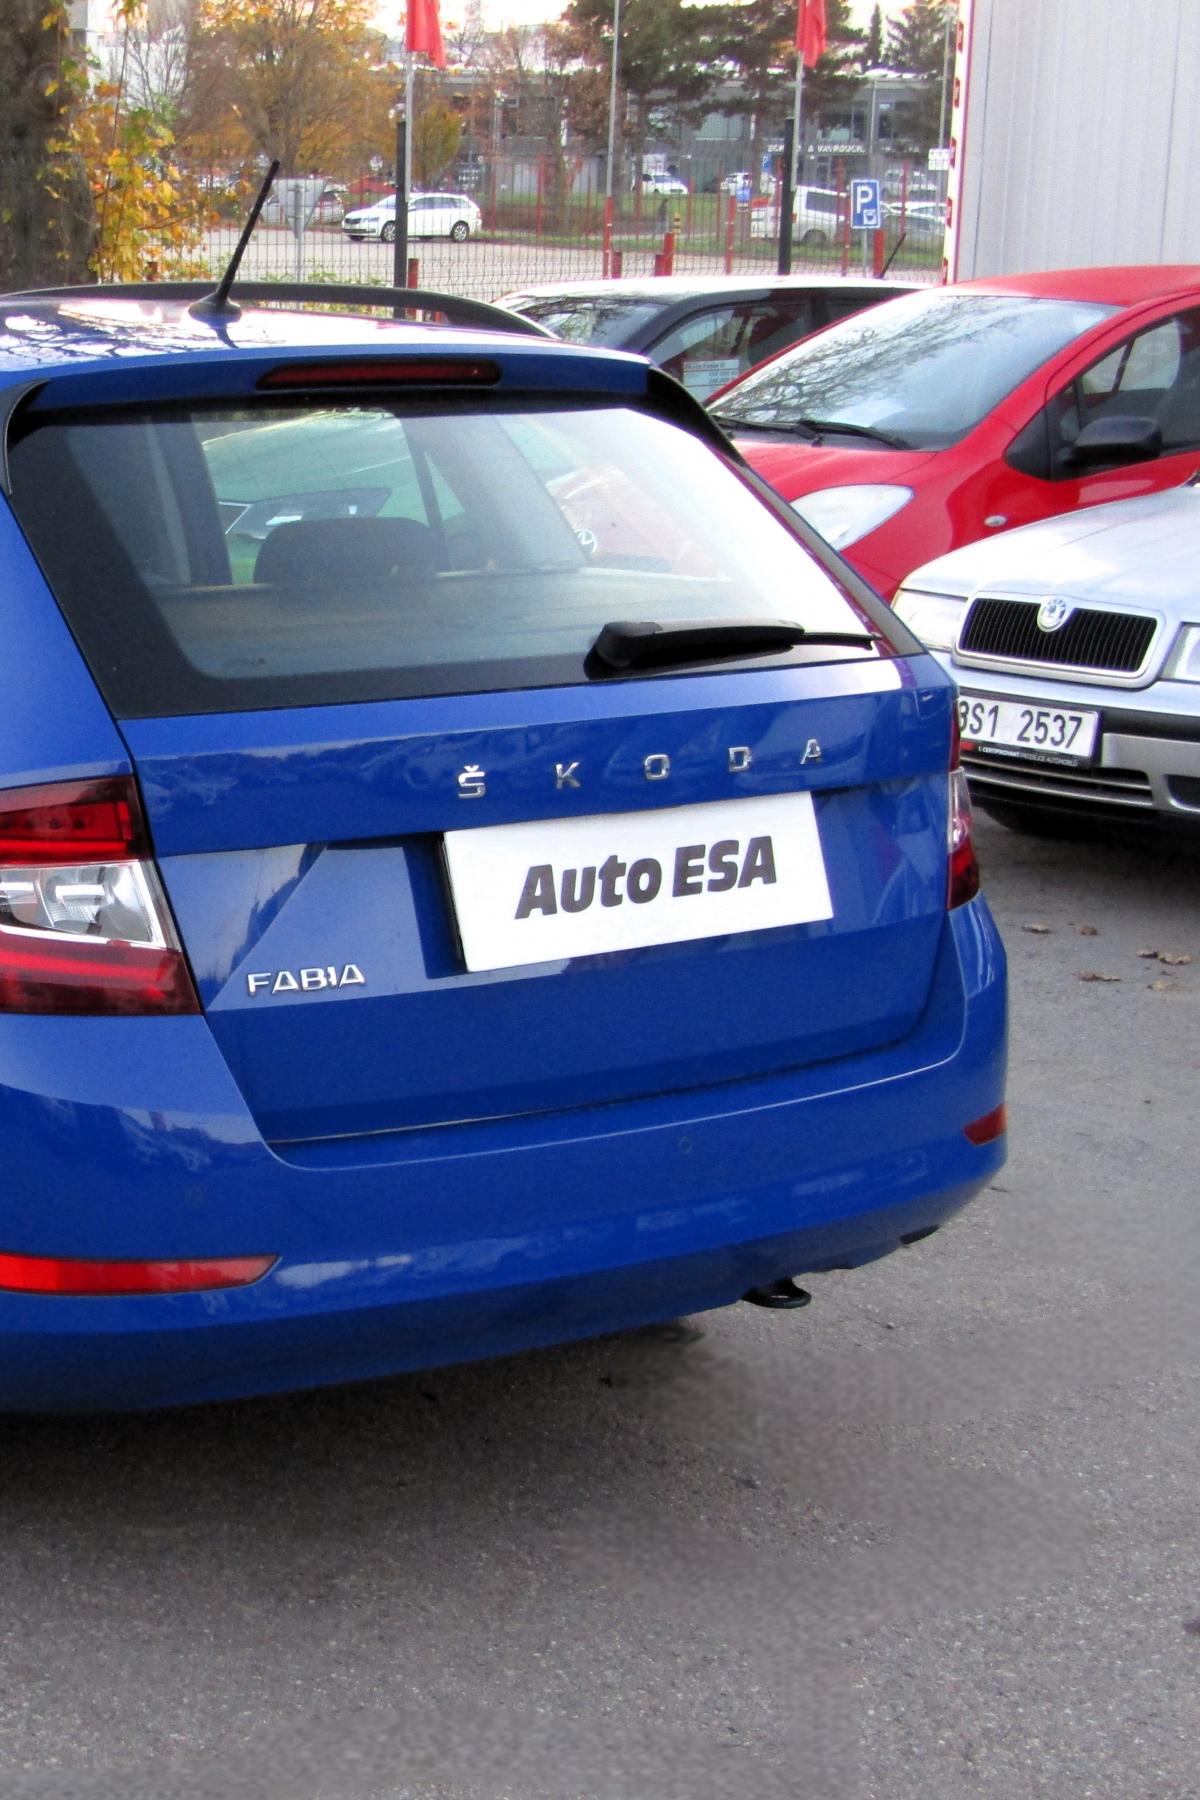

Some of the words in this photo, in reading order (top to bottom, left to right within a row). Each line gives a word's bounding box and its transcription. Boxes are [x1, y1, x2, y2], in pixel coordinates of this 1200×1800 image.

[856, 185, 873, 214] P
[1017, 709, 1082, 748] 2537
[458, 739, 823, 798] ŠKODA
[514, 855, 662, 919] Auto
[672, 835, 777, 897] ESA
[247, 964, 366, 997] FABIA
